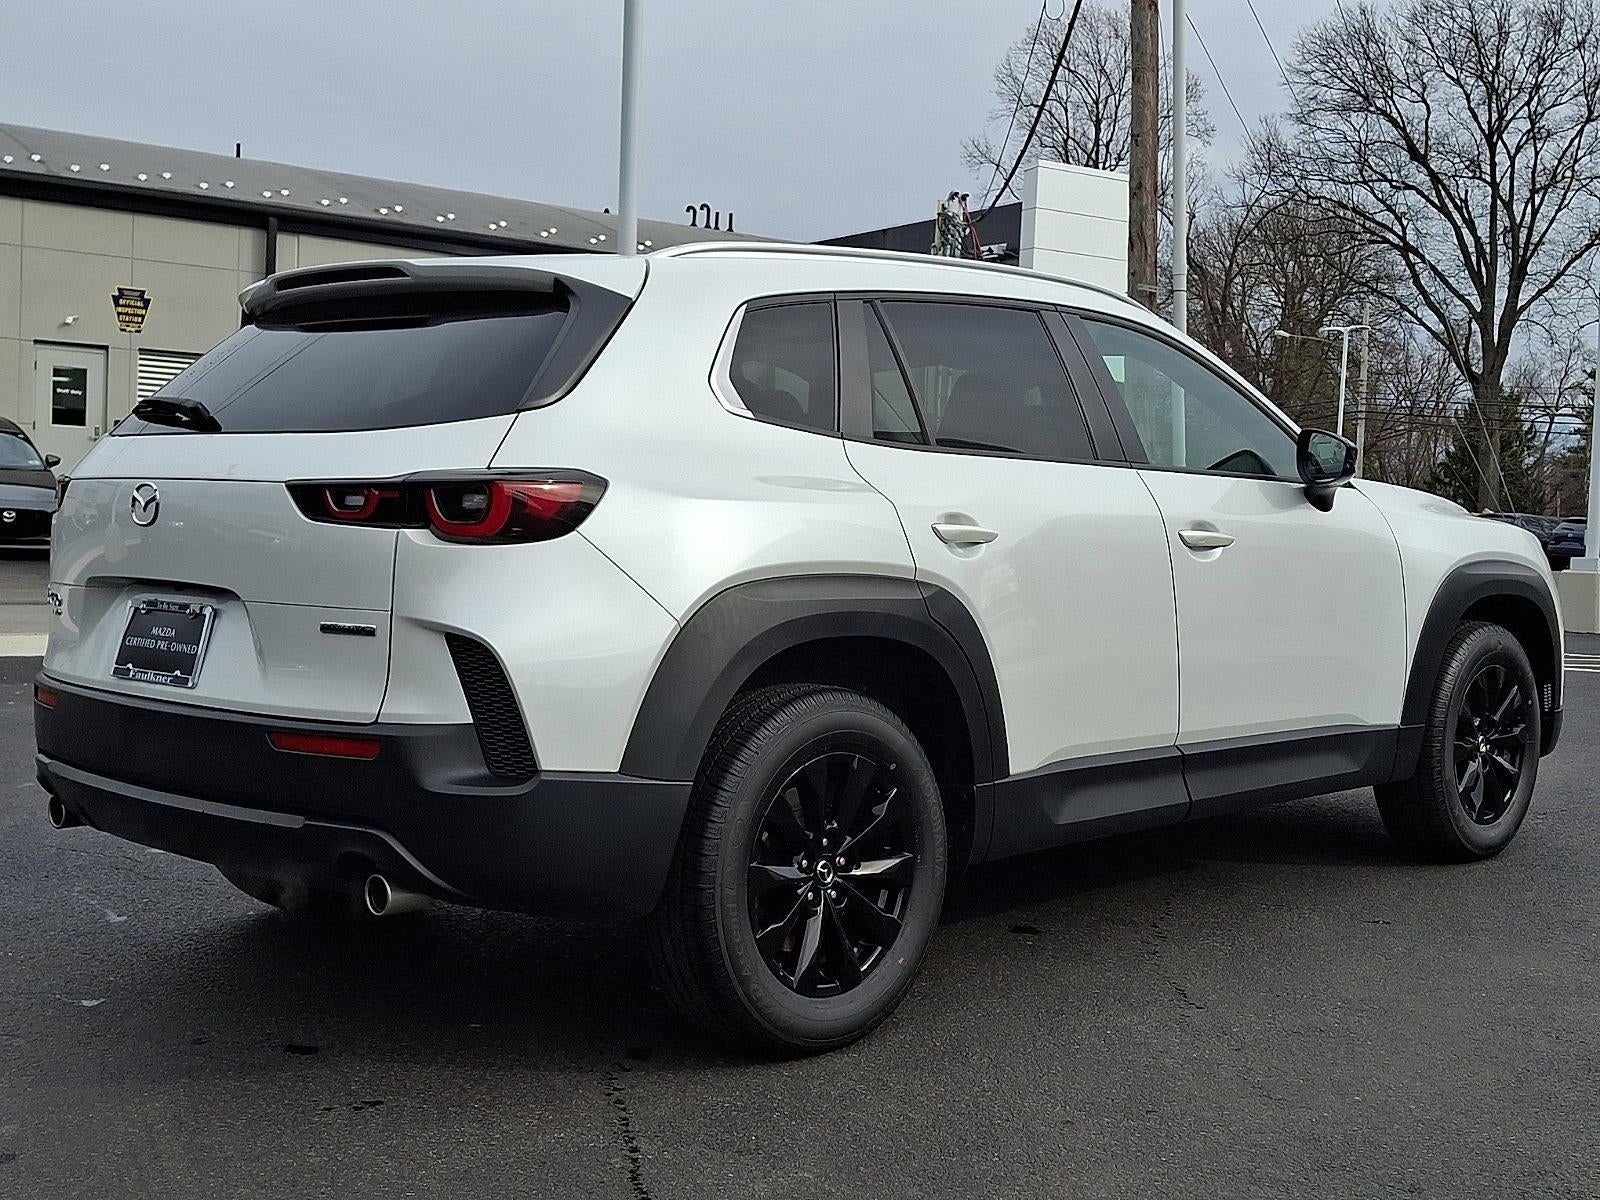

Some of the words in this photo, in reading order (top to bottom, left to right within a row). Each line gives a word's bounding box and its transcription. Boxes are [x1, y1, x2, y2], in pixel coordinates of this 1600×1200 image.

[151, 626, 176, 637] MAZDA
[125, 636, 156, 649] CERTIFIED
[156, 639, 197, 654] PRE-OWNED
[129, 669, 173, 683] Faulkner
[920, 770, 944, 877] YOKOHAMA
